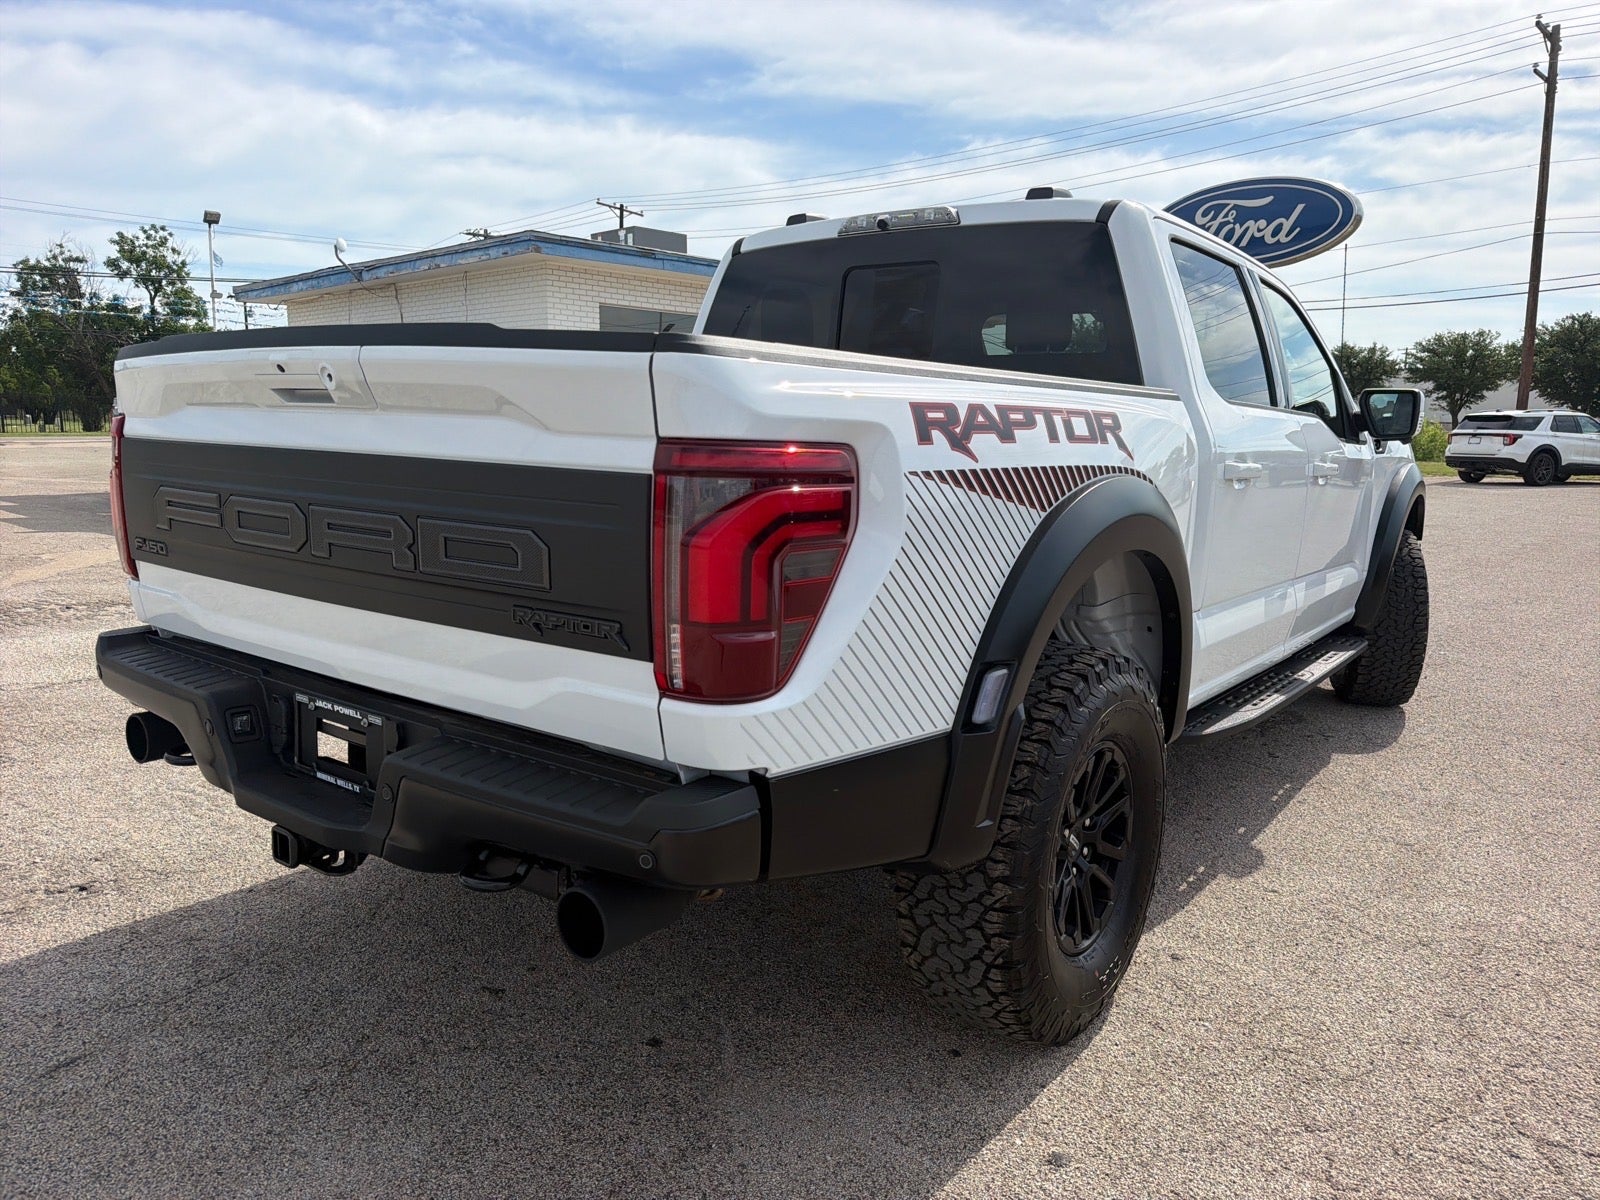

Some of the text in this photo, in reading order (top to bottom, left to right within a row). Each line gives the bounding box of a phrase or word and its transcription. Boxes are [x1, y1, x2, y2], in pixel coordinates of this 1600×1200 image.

[1195, 195, 1306, 248] Ford
[909, 401, 1134, 463] RAPTOR
[153, 484, 552, 591] FORD
[512, 604, 631, 652] RAPTOR
[314, 699, 363, 719] JACK POWELL
